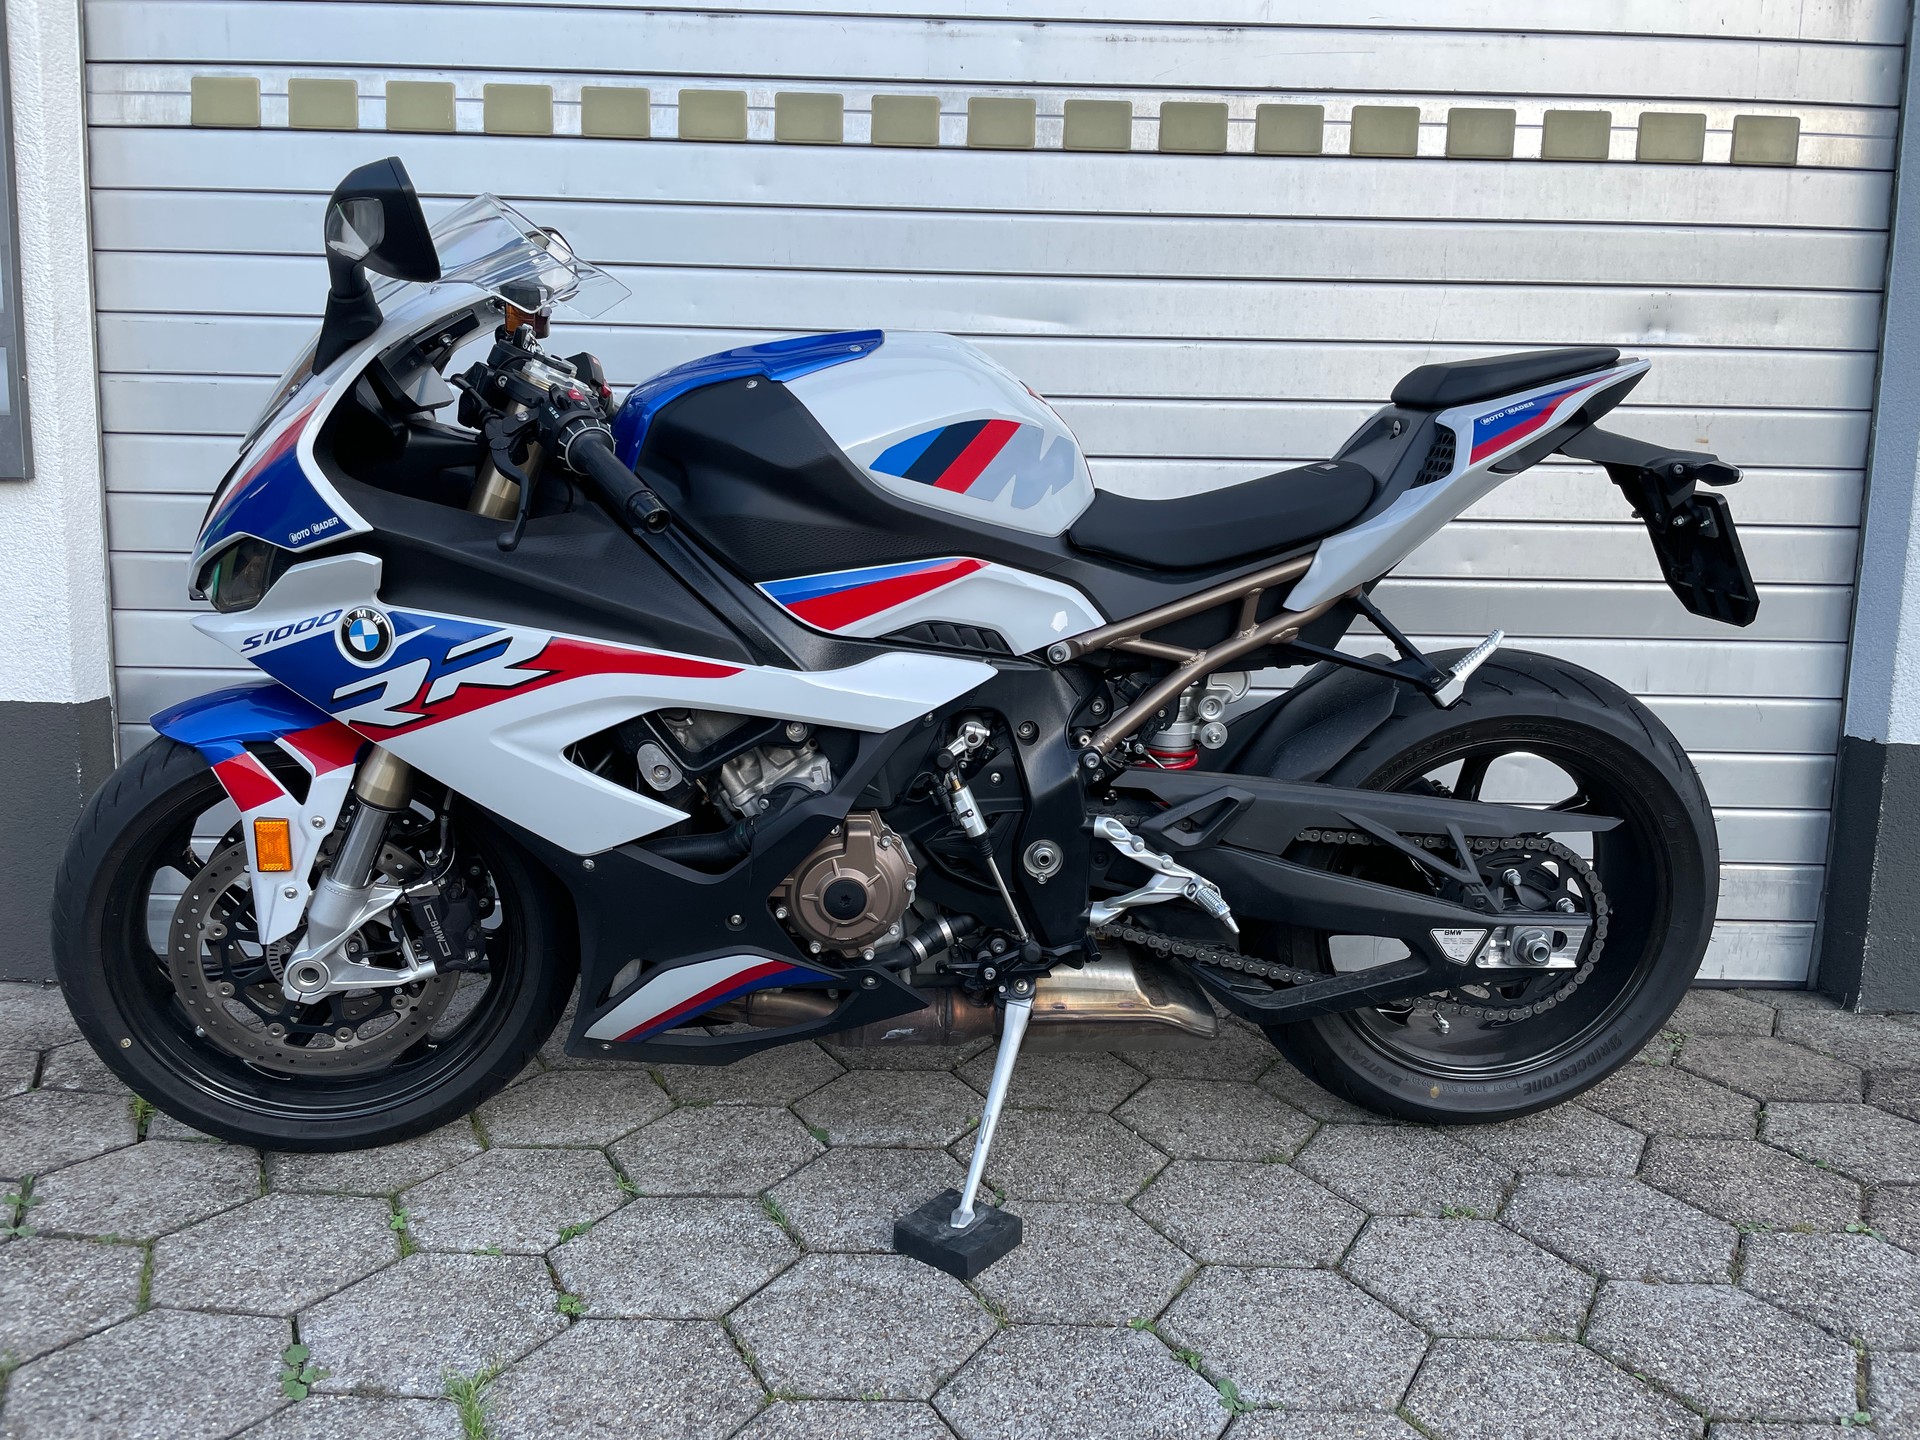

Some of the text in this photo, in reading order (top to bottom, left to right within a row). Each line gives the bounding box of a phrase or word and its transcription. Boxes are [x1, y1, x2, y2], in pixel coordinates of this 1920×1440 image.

[1480, 401, 1535, 425] MOTO MADER
[289, 516, 339, 544] MOTO MADER
[240, 608, 344, 653] S1000
[342, 608, 384, 629] BMW
[331, 631, 564, 728] RR
[429, 919, 446, 943] BMW
[1522, 1033, 1623, 1096] BRIDGESTONE
